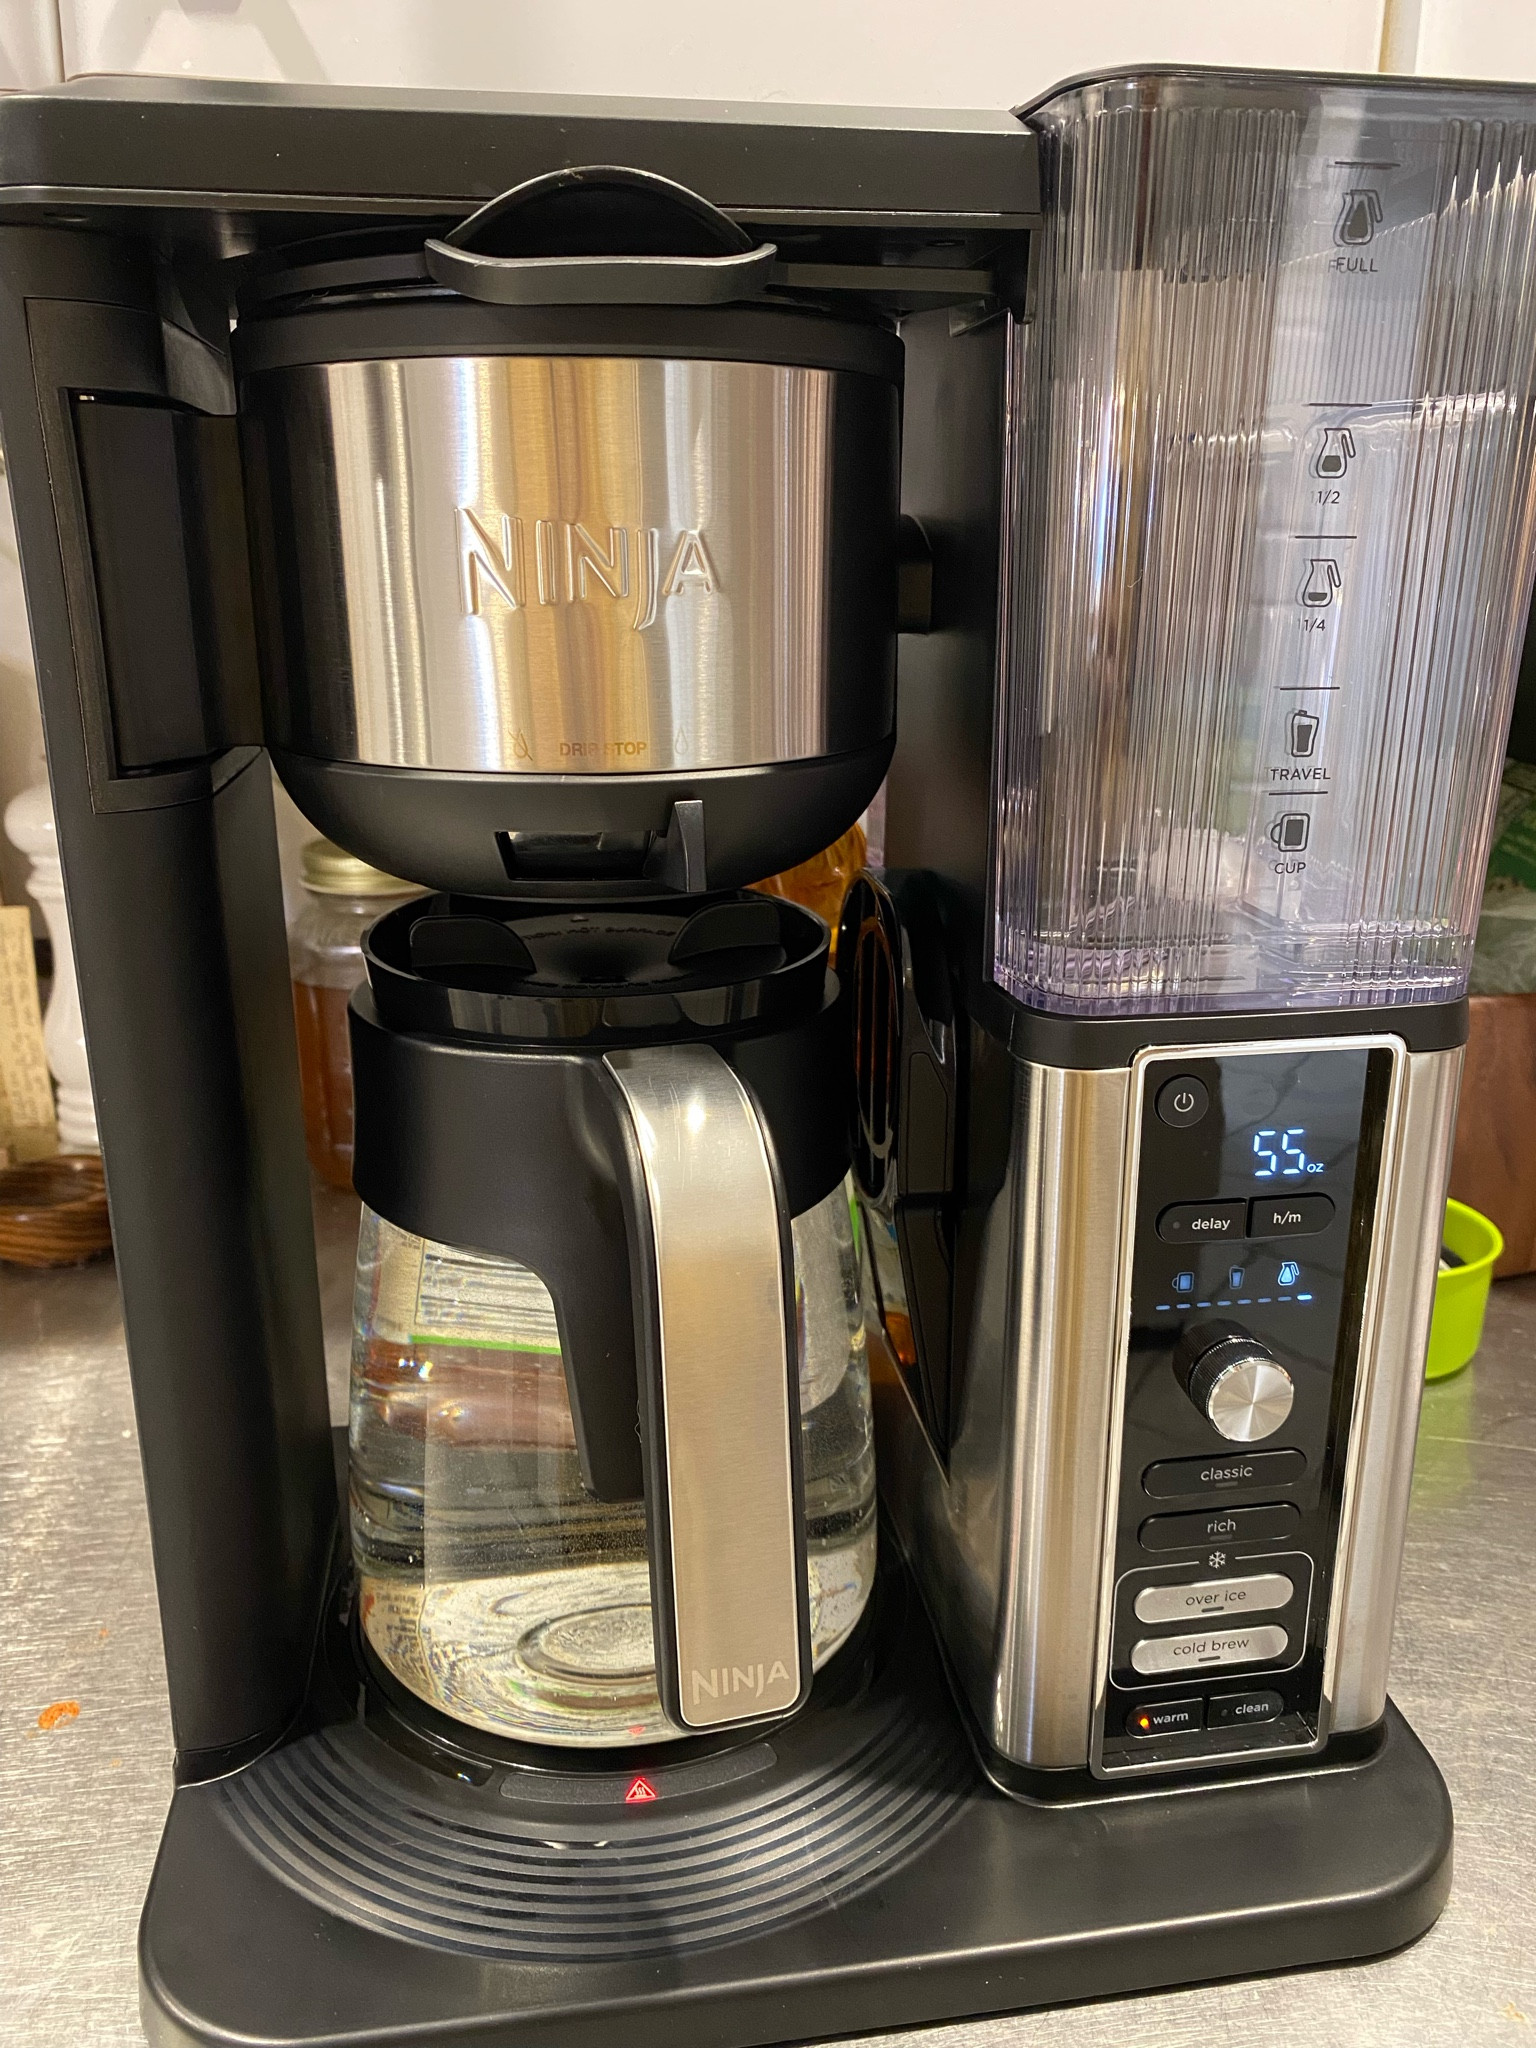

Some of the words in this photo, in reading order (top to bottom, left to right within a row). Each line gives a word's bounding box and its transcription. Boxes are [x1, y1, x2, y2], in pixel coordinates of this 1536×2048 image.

[1334, 257, 1378, 273] FULL
[1317, 490, 1340, 505] 1/2
[454, 506, 722, 631] NINJA
[1304, 619, 1326, 633] 1/4
[559, 741, 599, 757] DRIP
[1270, 768, 1331, 782] TRAVEL
[1274, 862, 1307, 875] CUP
[1253, 1128, 1305, 1176] 55
[1306, 1162, 1324, 1173] oz
[1191, 1216, 1231, 1231] delay
[1273, 1210, 1302, 1225] h/m
[1200, 1465, 1253, 1481] classic
[1206, 1519, 1236, 1533] rich
[1185, 1593, 1219, 1606] over
[1223, 1589, 1247, 1602] ice
[1173, 1642, 1206, 1656] cold
[1210, 1637, 1250, 1651] brew
[691, 1660, 790, 1705] NINJA
[1235, 1701, 1269, 1715] clean
[1153, 1711, 1189, 1724] warm
